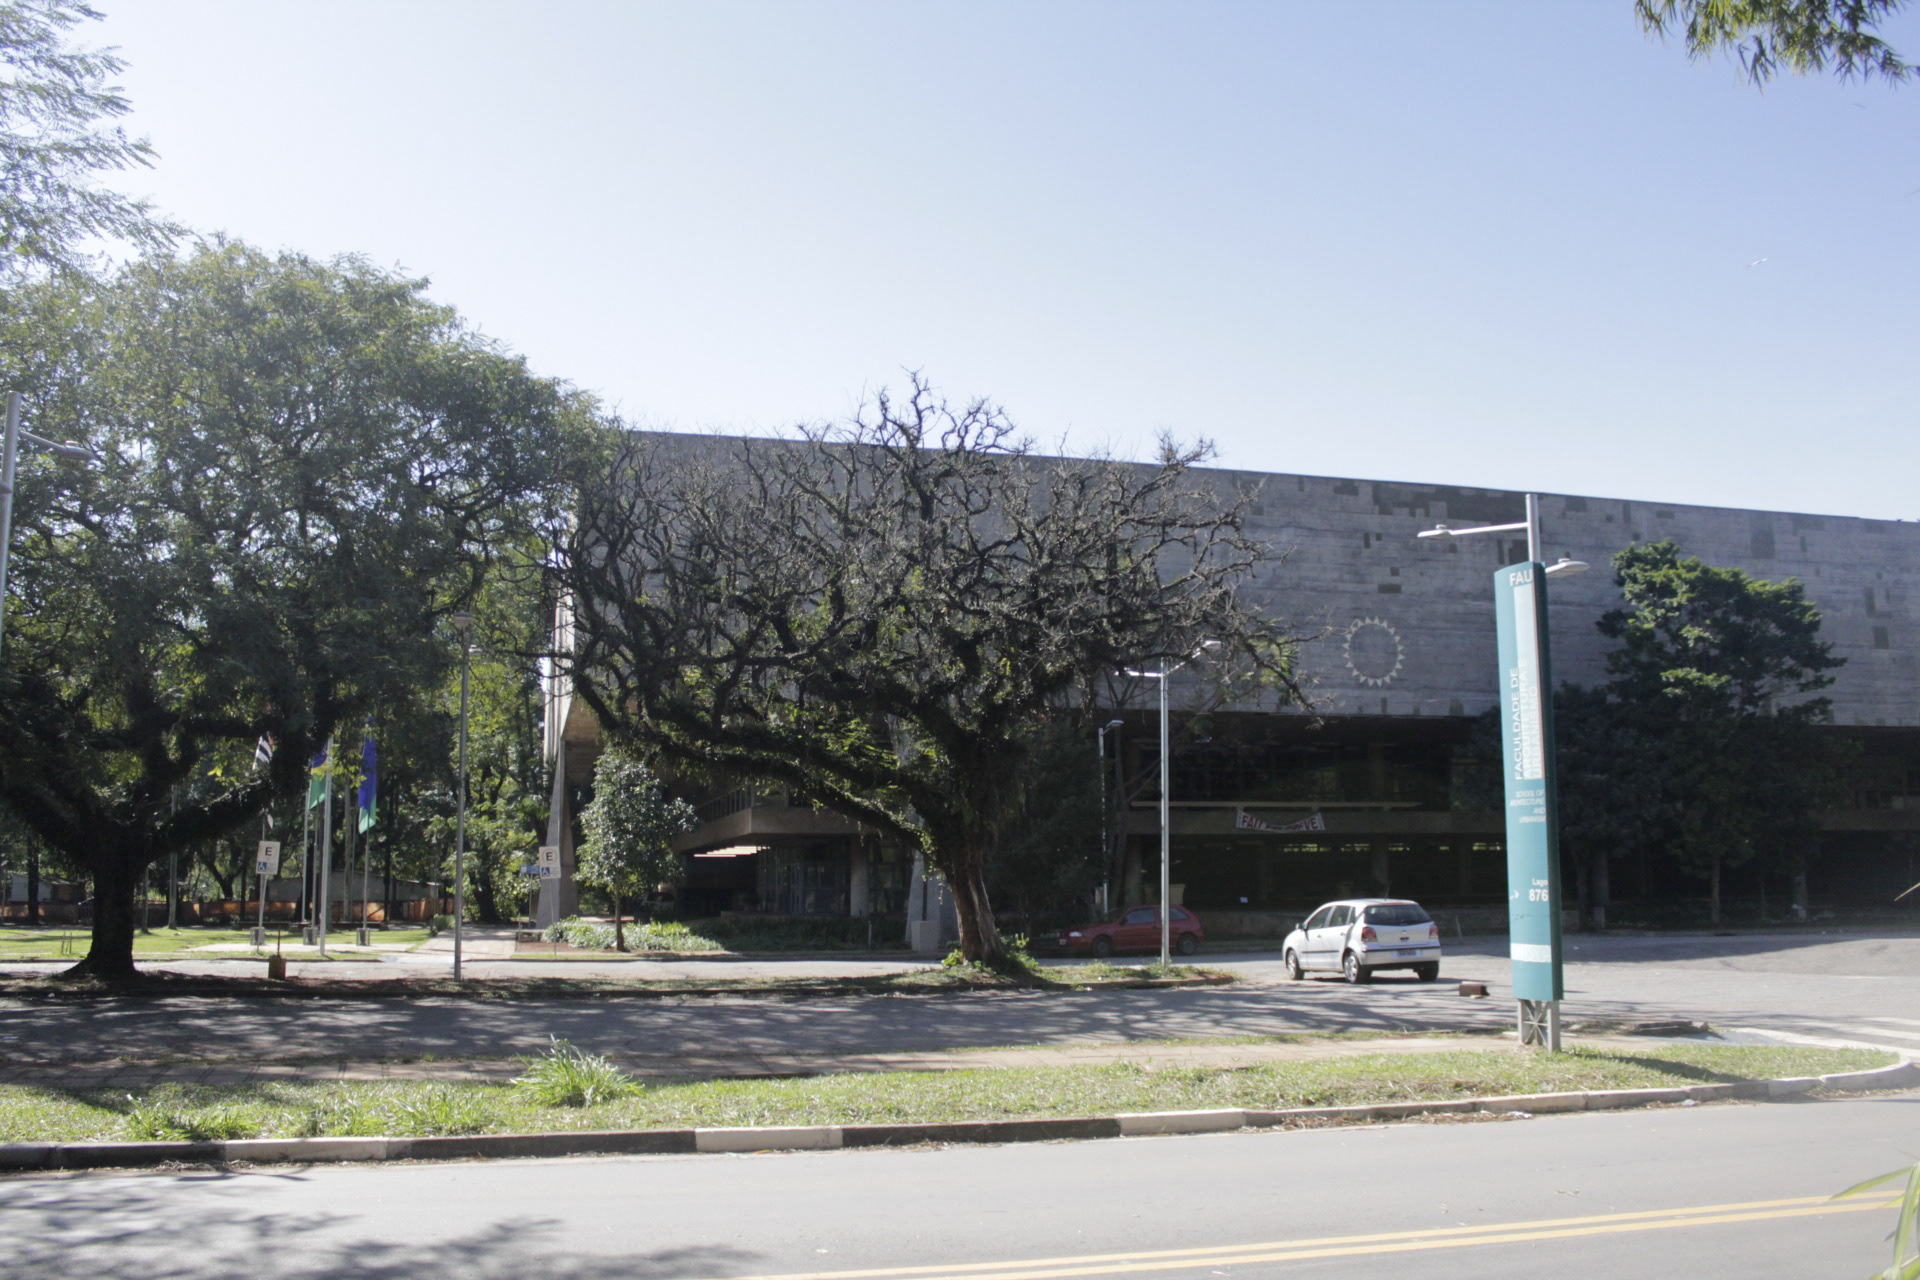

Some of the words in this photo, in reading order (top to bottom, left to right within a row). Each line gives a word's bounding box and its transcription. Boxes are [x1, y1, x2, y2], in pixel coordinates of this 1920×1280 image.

[1510, 569, 1533, 587] FAU
[1510, 668, 1520, 688] DE
[1519, 671, 1532, 779] ARQUITETURA
[1529, 686, 1541, 778] URBANISMO
[1511, 691, 1523, 780] FACULDADE
[265, 847, 273, 856] E
[546, 852, 553, 861] E
[1532, 878, 1549, 887] Lago
[1529, 889, 1549, 902] 876
